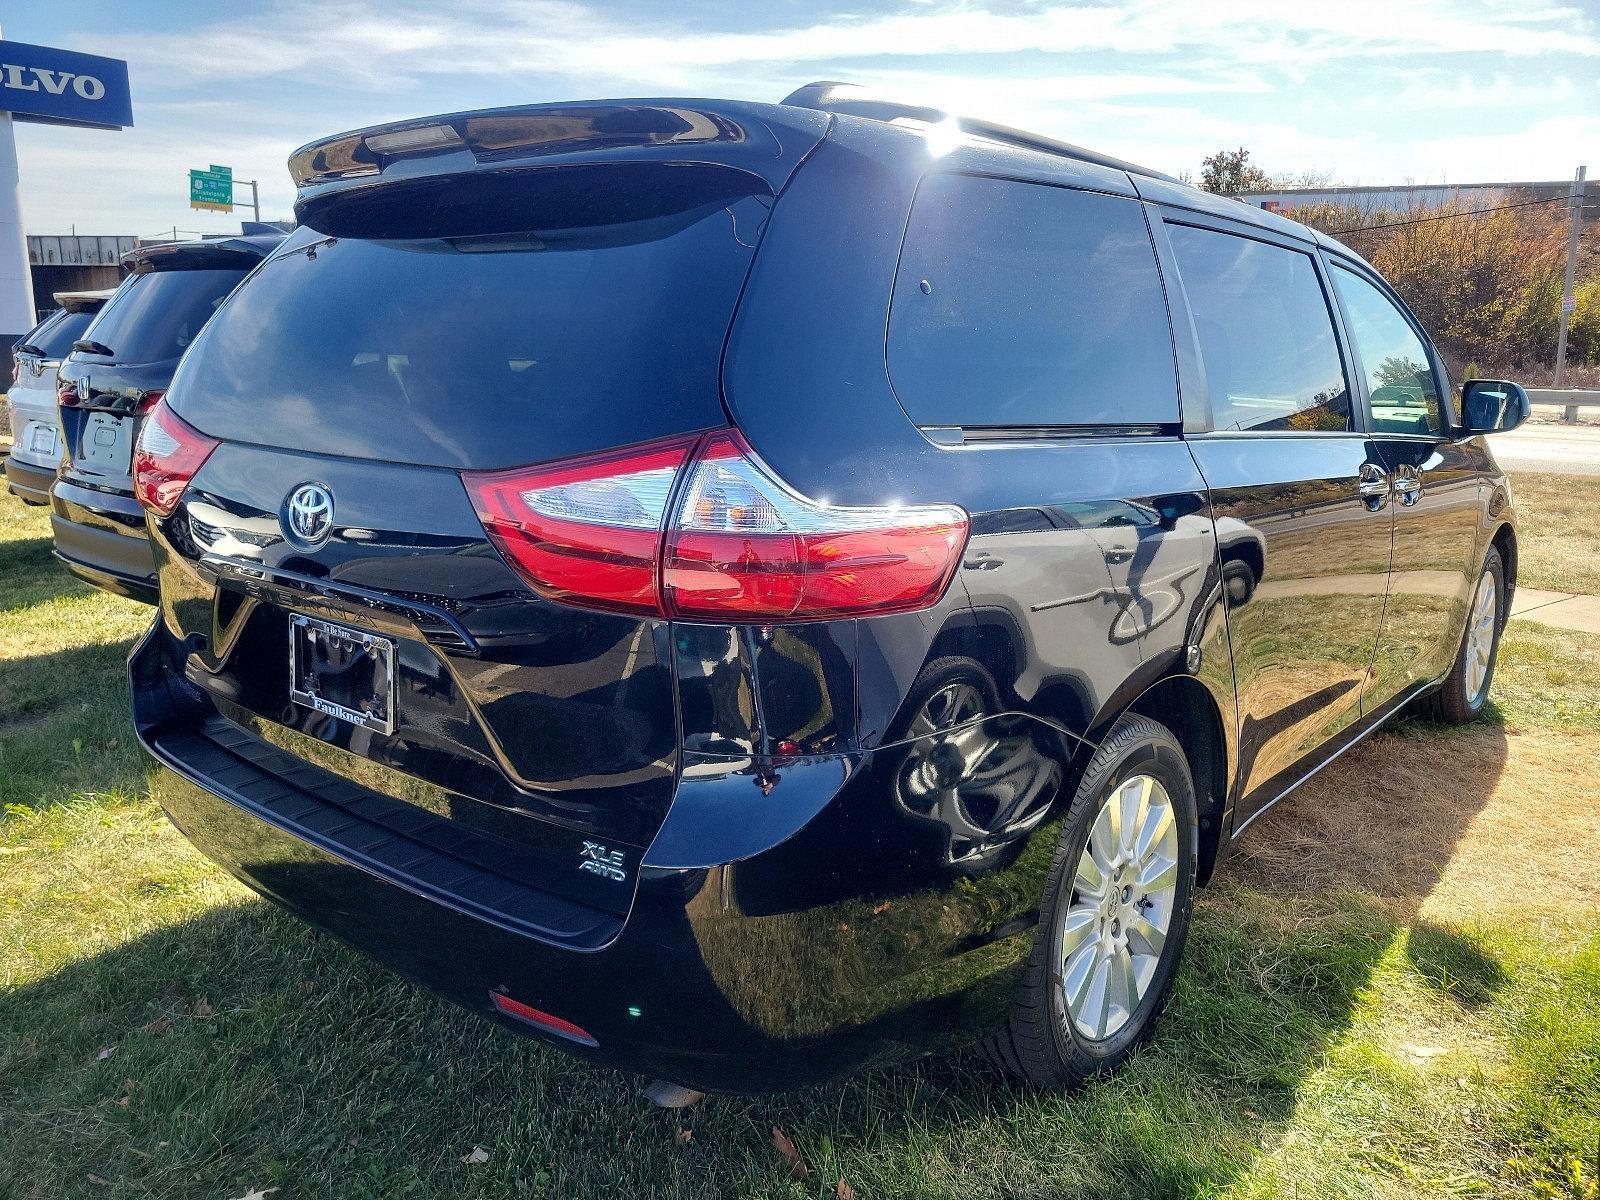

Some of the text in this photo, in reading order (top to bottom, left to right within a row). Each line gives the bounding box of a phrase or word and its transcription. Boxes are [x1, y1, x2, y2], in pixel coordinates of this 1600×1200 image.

[0, 64, 105, 100] LVO
[330, 627, 338, 635] Be
[338, 630, 351, 639] Sure
[314, 699, 367, 725] Faulkner
[580, 840, 625, 867] XLE
[579, 860, 626, 881] AWD
